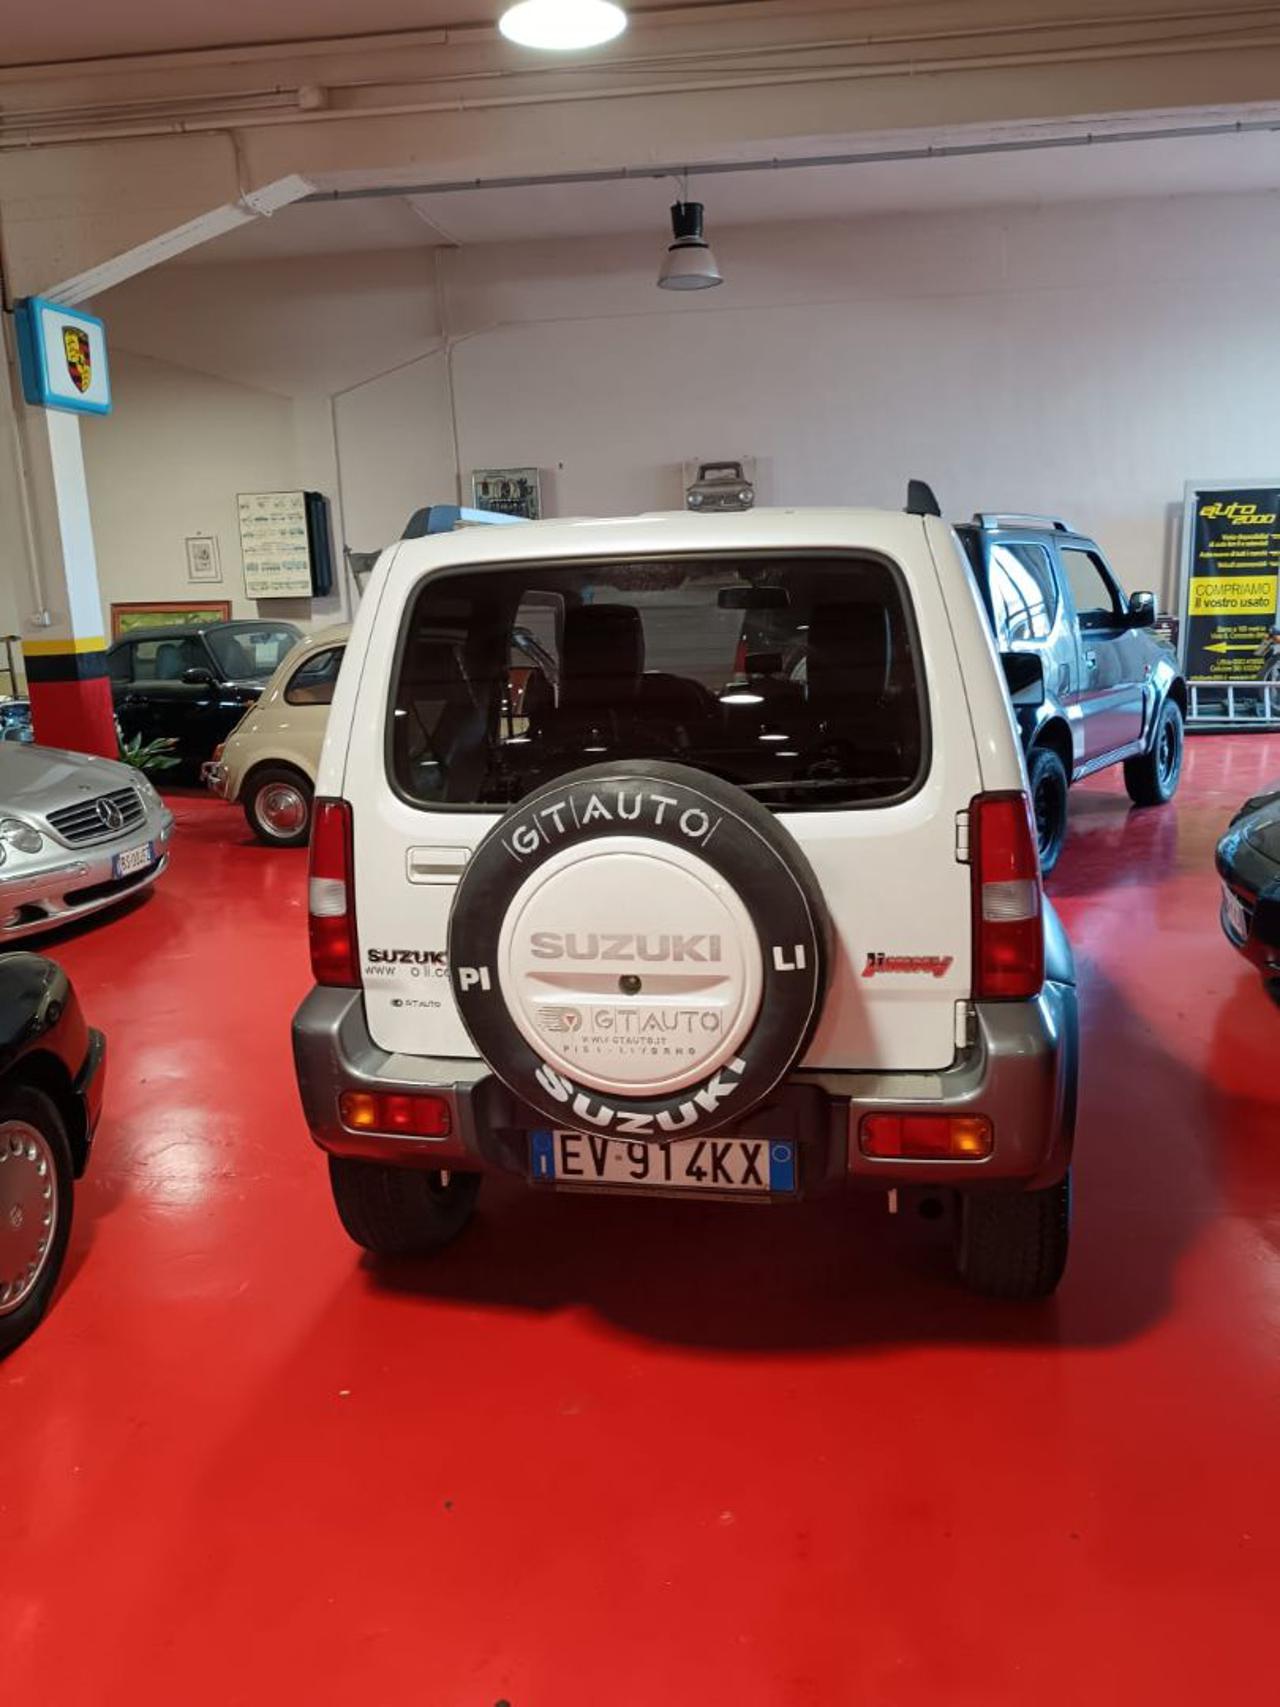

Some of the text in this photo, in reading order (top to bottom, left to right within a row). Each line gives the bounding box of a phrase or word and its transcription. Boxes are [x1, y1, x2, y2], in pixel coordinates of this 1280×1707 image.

[1232, 513, 1276, 525] 2000
[1195, 582, 1271, 597] COMPRIAMO
[1203, 597, 1238, 608] vostro
[1240, 597, 1270, 608] usato
[367, 948, 447, 966] SUZUK
[530, 931, 722, 963] SUZUKI
[772, 944, 806, 972] LI
[458, 966, 492, 992] PI
[534, 1055, 747, 1136] SUZUKI
